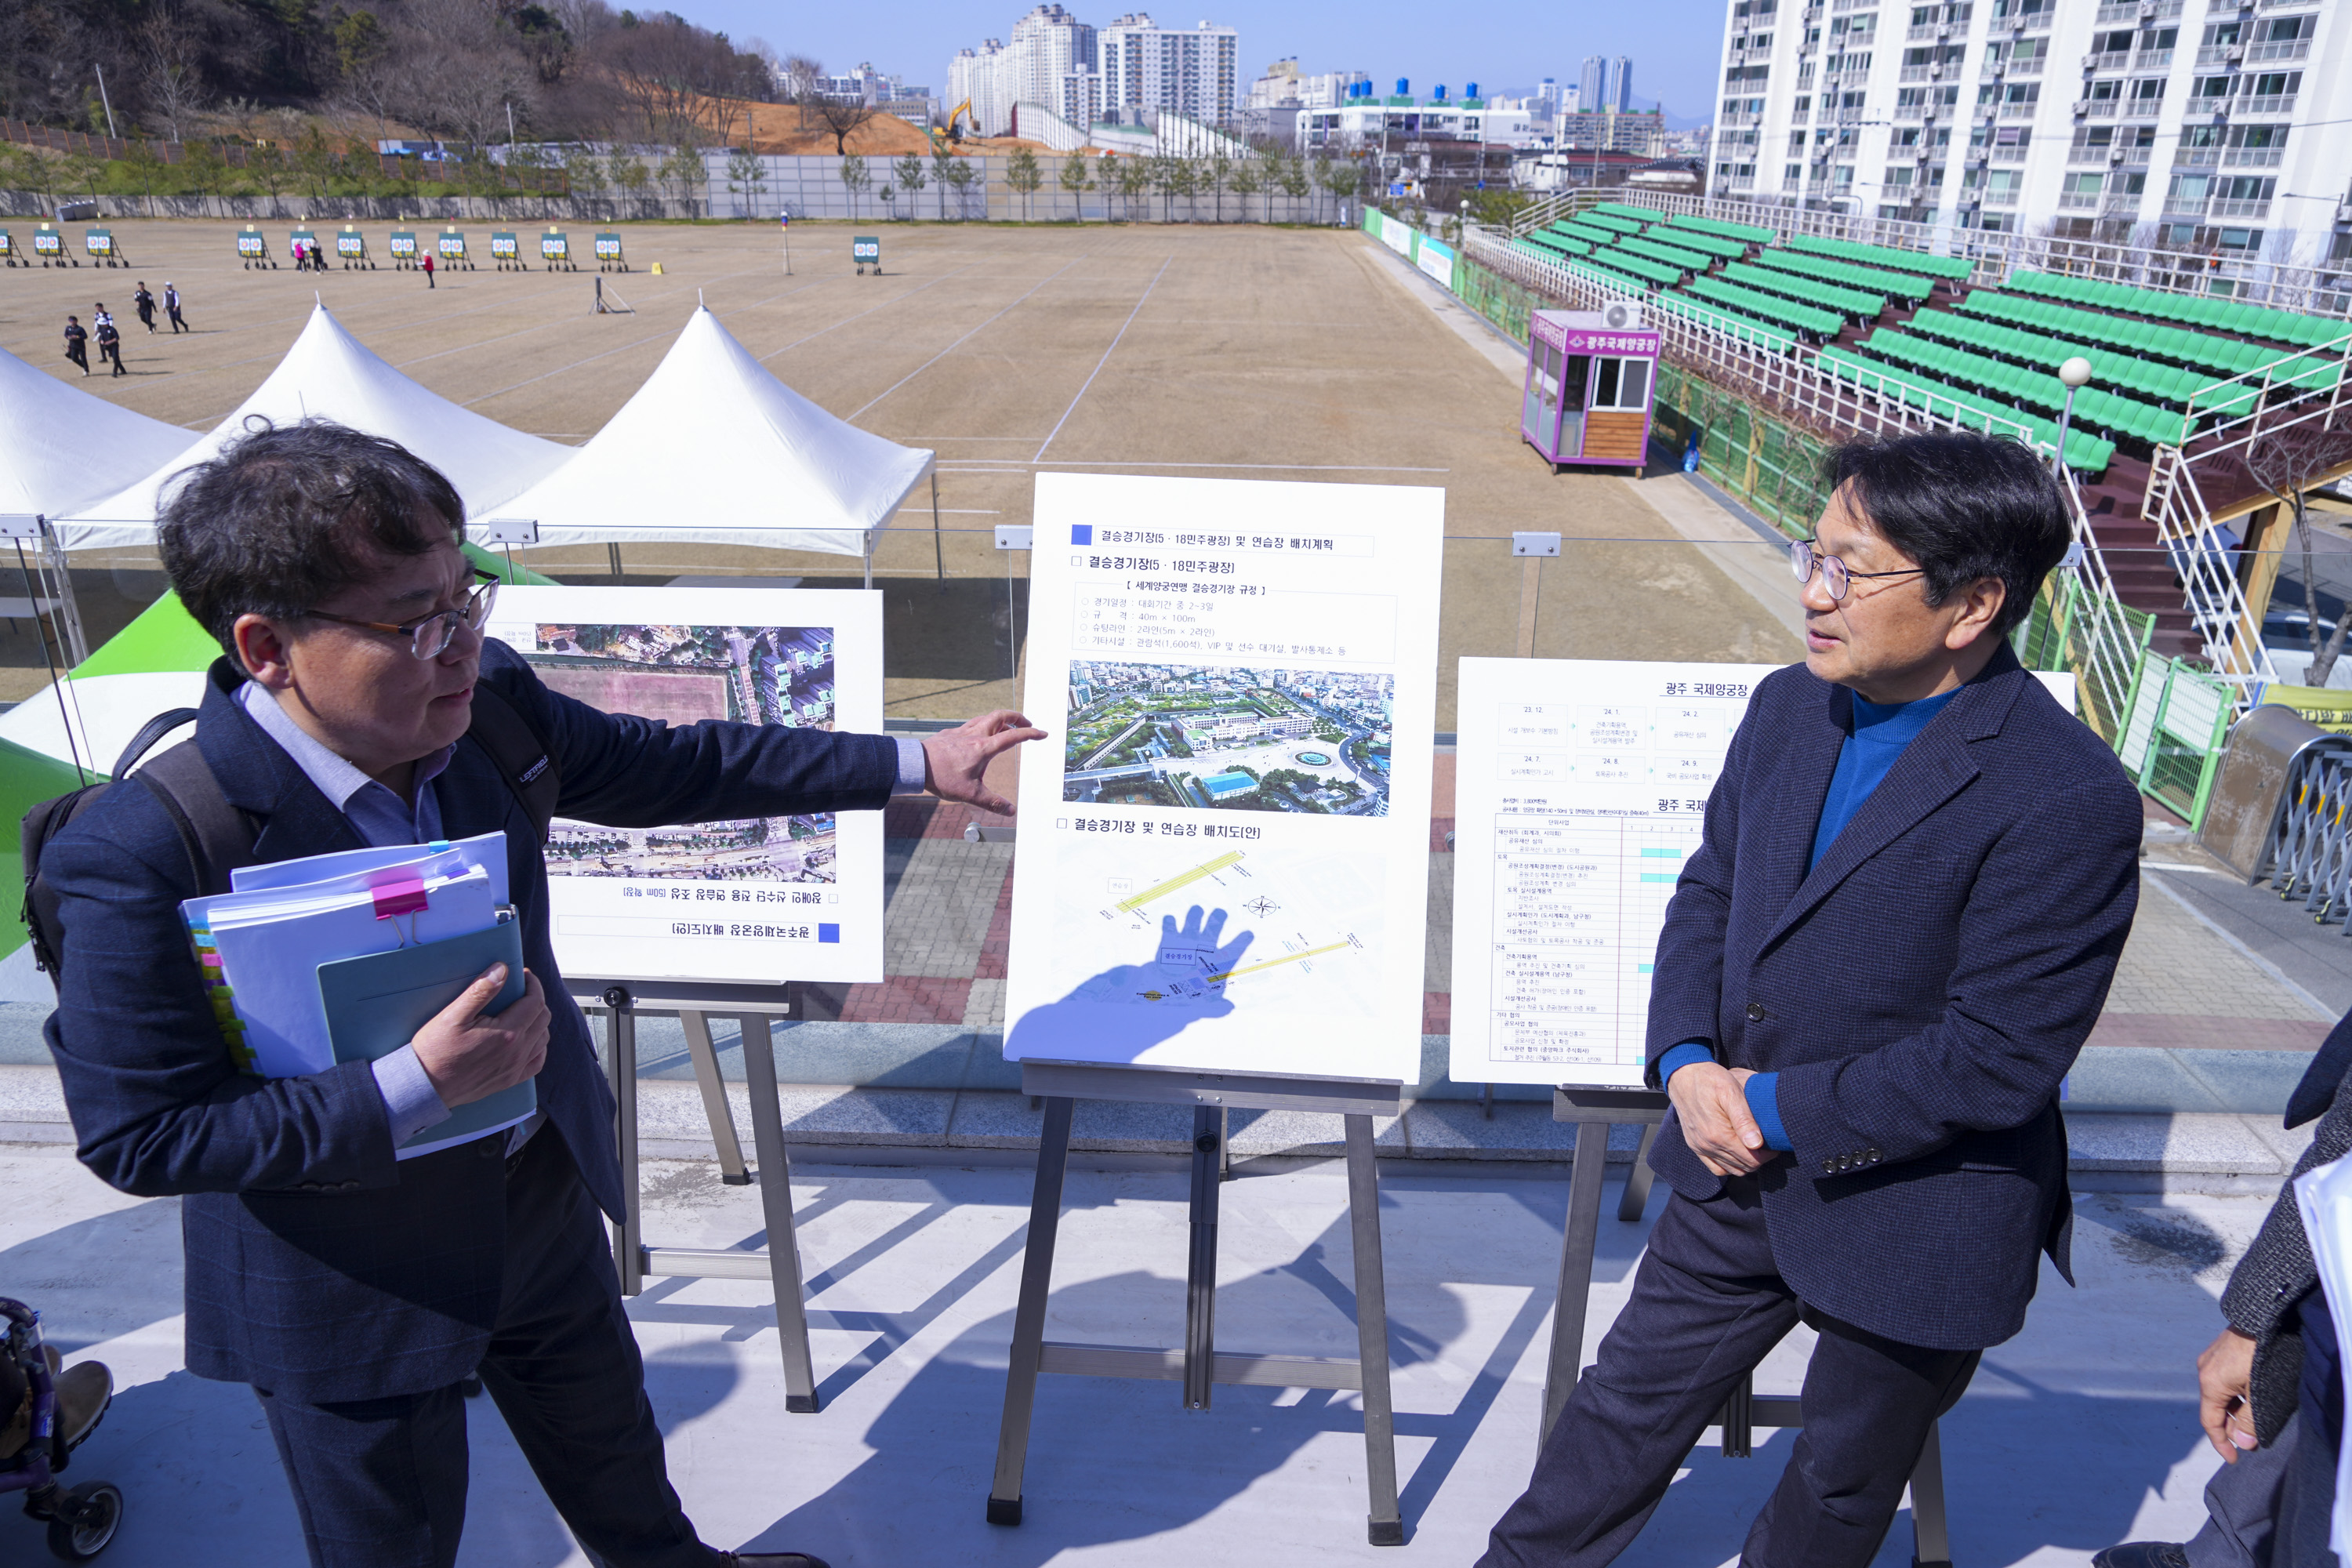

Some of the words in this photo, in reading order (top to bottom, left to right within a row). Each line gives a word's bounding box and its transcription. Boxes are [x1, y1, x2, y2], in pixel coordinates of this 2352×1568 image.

[1587, 336, 1657, 352] 광주국제양궁장
[1236, 535, 1245, 546] 및
[1253, 536, 1284, 549] 연습장
[1290, 538, 1333, 550] 배치계획
[1136, 581, 1188, 592] 세계양궁연맹
[1192, 583, 1236, 594] 결승경기장
[1240, 585, 1257, 595] 규정
[1094, 597, 1127, 608] 경기일정
[1138, 599, 1171, 610] 대회기간
[1176, 601, 1185, 610] 중
[1189, 602, 1214, 612] 2~3일
[1093, 611, 1101, 619] 규
[1120, 612, 1127, 620] 격
[1138, 613, 1157, 622] 40m
[1172, 614, 1196, 622] 100m
[1093, 623, 1126, 633] 슈팅라인
[1137, 626, 1176, 635] 2라인(5m
[1189, 628, 1215, 637] 2라인)
[1092, 636, 1125, 646] 기타시설
[1207, 641, 1221, 650] VIP
[1225, 642, 1233, 651] 및
[1238, 643, 1254, 652] 선수
[1291, 644, 1334, 655] 발사통제소
[1338, 646, 1346, 656] 등
[1666, 682, 1687, 695] 광주
[1693, 683, 1748, 696] 국제양궁장
[1658, 799, 1679, 811] 광주
[1075, 818, 1136, 833] 결승경기장
[1142, 821, 1154, 834] 및
[1161, 822, 1197, 837] 연습장
[1204, 825, 1261, 840] 배치도(안)
[623, 887, 642, 897] 확장)
[647, 887, 666, 898] (50m
[671, 887, 690, 900] 조성
[697, 888, 725, 901] 연습장
[731, 889, 750, 902] 전용
[757, 891, 786, 902] 선수단
[792, 891, 821, 904] 장애인
[673, 923, 724, 935] 배치도(안)
[731, 924, 809, 938] 광주국제양궁장
